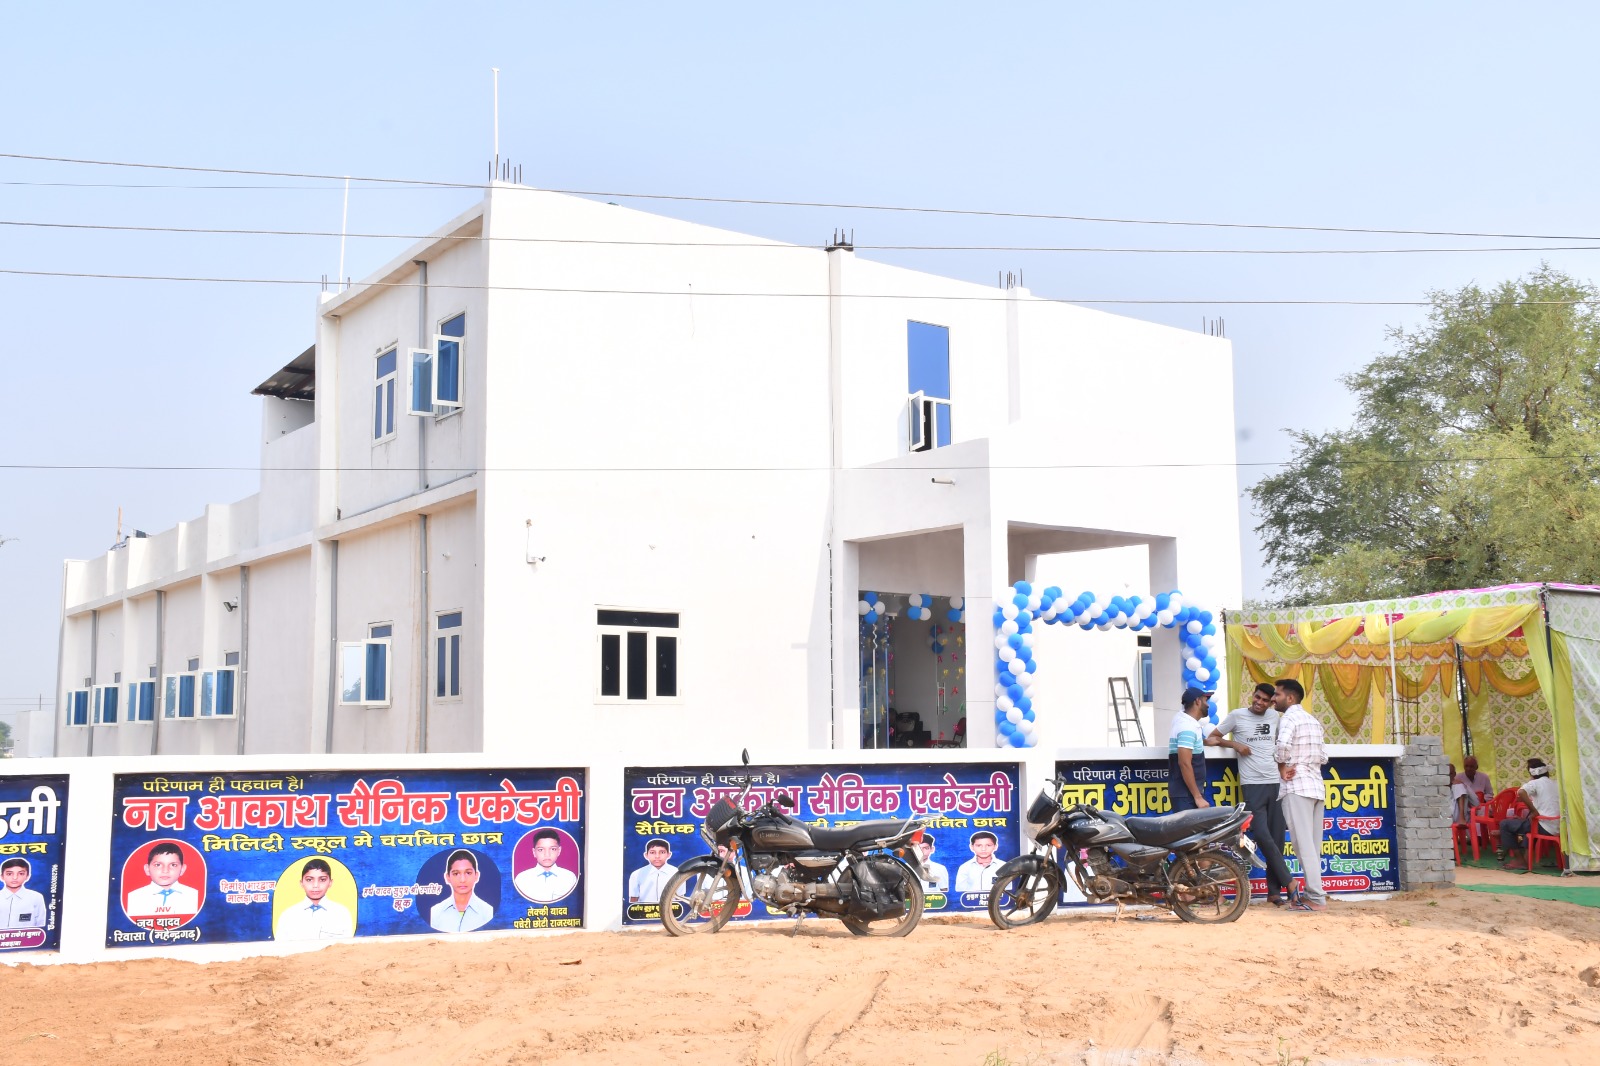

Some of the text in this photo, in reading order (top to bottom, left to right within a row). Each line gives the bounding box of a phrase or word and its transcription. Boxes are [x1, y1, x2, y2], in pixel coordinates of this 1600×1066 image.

[647, 772, 780, 785] परिणाम ही पहचन है।
[1073, 767, 1116, 780] परिणाम
[1119, 766, 1131, 782] ही
[143, 775, 304, 793] परिणाम ही पहचान है।
[1062, 784, 1106, 812] नव
[1324, 765, 1389, 812] केडमी
[631, 787, 685, 818] नव
[808, 772, 902, 815] सैनिक
[908, 771, 1013, 815] एकेडमी
[123, 776, 583, 831] नव आकाश सैनिक एकेडमी
[635, 820, 694, 835] सैनिक
[974, 817, 1007, 828] छात्र
[1337, 816, 1383, 835] स्कूल
[203, 833, 284, 852] मिलिट्री
[292, 835, 347, 853] स्कूल
[380, 829, 454, 847] चयनित
[462, 831, 503, 845] छात्र
[1321, 834, 1389, 855] वोदय विद्यालय
[1330, 855, 1391, 878] देहरादून
[550, 907, 568, 916] यादव
[136, 917, 180, 929] जय यादव
[550, 918, 581, 927] राजस्थान
[114, 930, 146, 943] रिवासा
